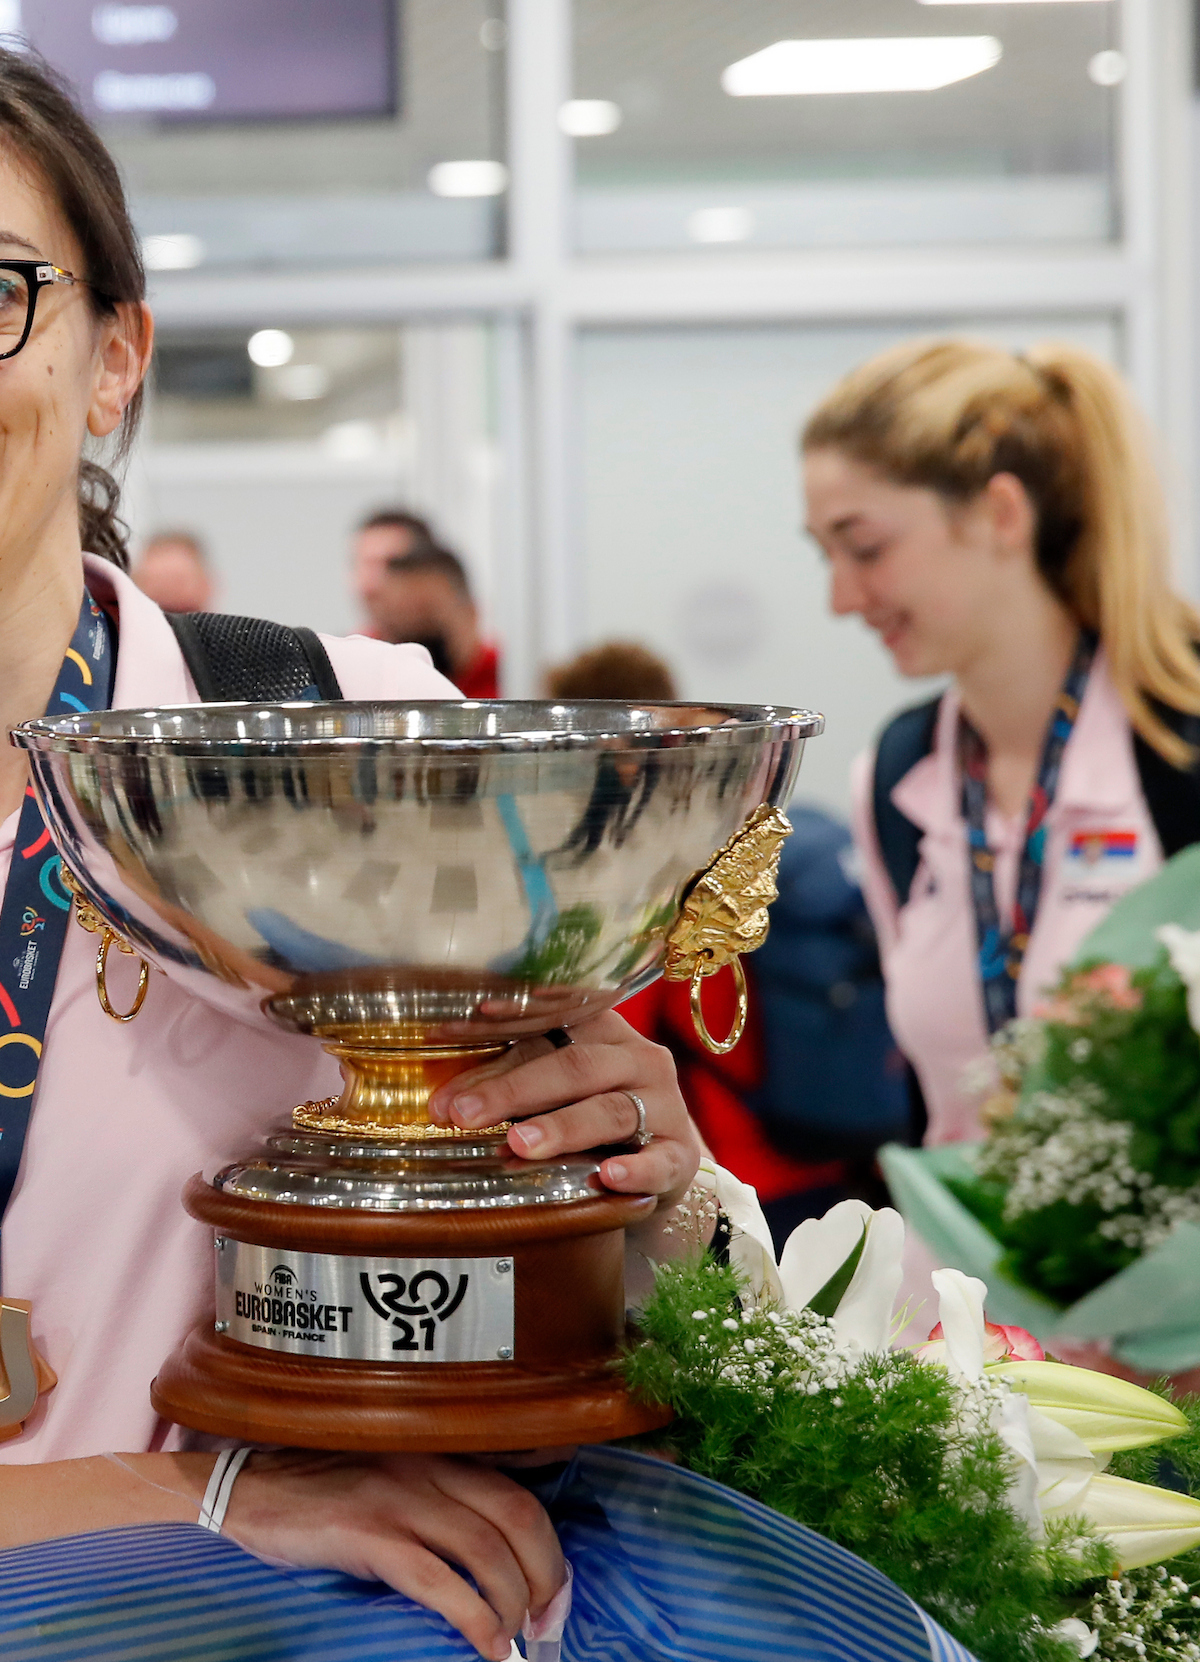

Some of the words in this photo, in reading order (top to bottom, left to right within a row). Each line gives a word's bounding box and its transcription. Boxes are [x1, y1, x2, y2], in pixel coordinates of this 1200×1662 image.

[19, 940, 37, 989] EUROBASKET
[274, 1272, 292, 1286] FIBA
[254, 1281, 318, 1303] WOMEN'S
[235, 1289, 353, 1333] EUROBASKET
[251, 1323, 277, 1337] SPAIN
[282, 1329, 326, 1343] FRANCE
